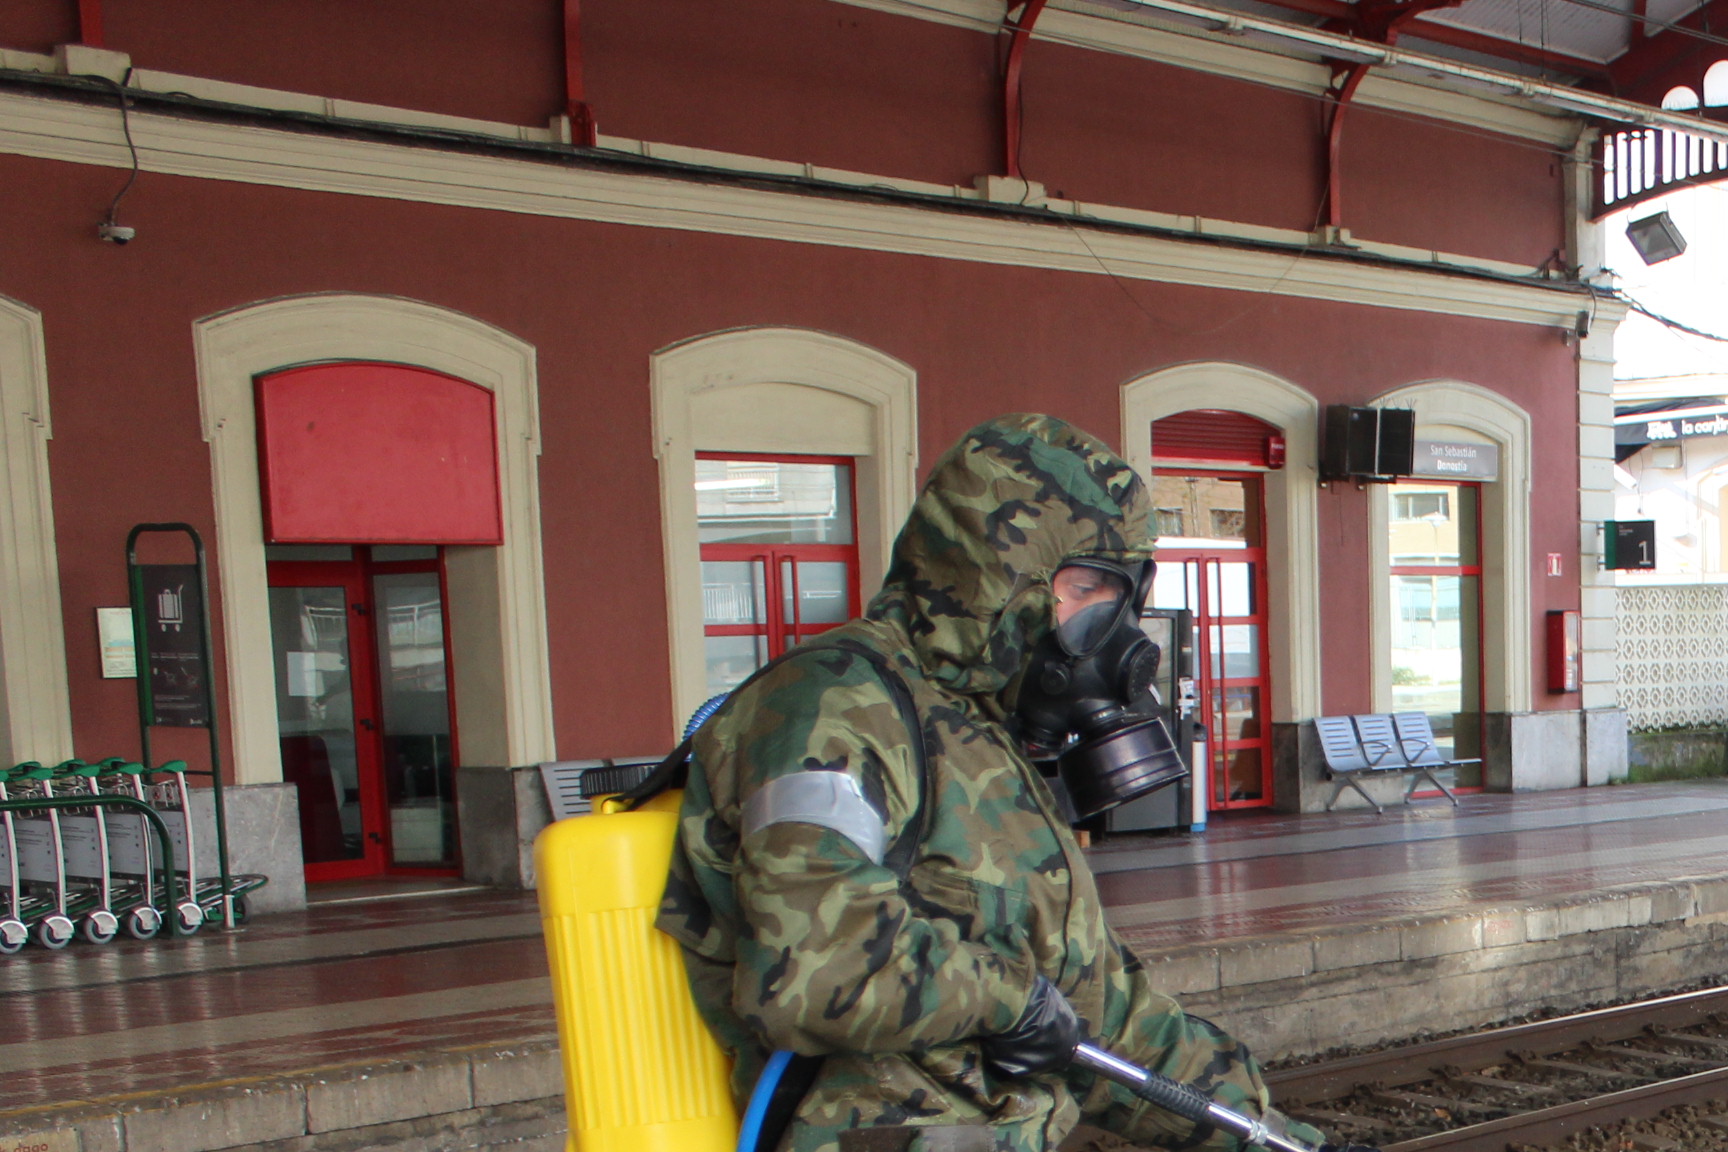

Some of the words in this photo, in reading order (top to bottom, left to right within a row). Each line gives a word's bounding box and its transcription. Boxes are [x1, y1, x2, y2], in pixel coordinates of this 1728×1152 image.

[1430, 444, 1442, 456] San
[1444, 445, 1477, 459] Sebastián
[1437, 459, 1468, 472] Donostia
[1638, 540, 1652, 566] 1
